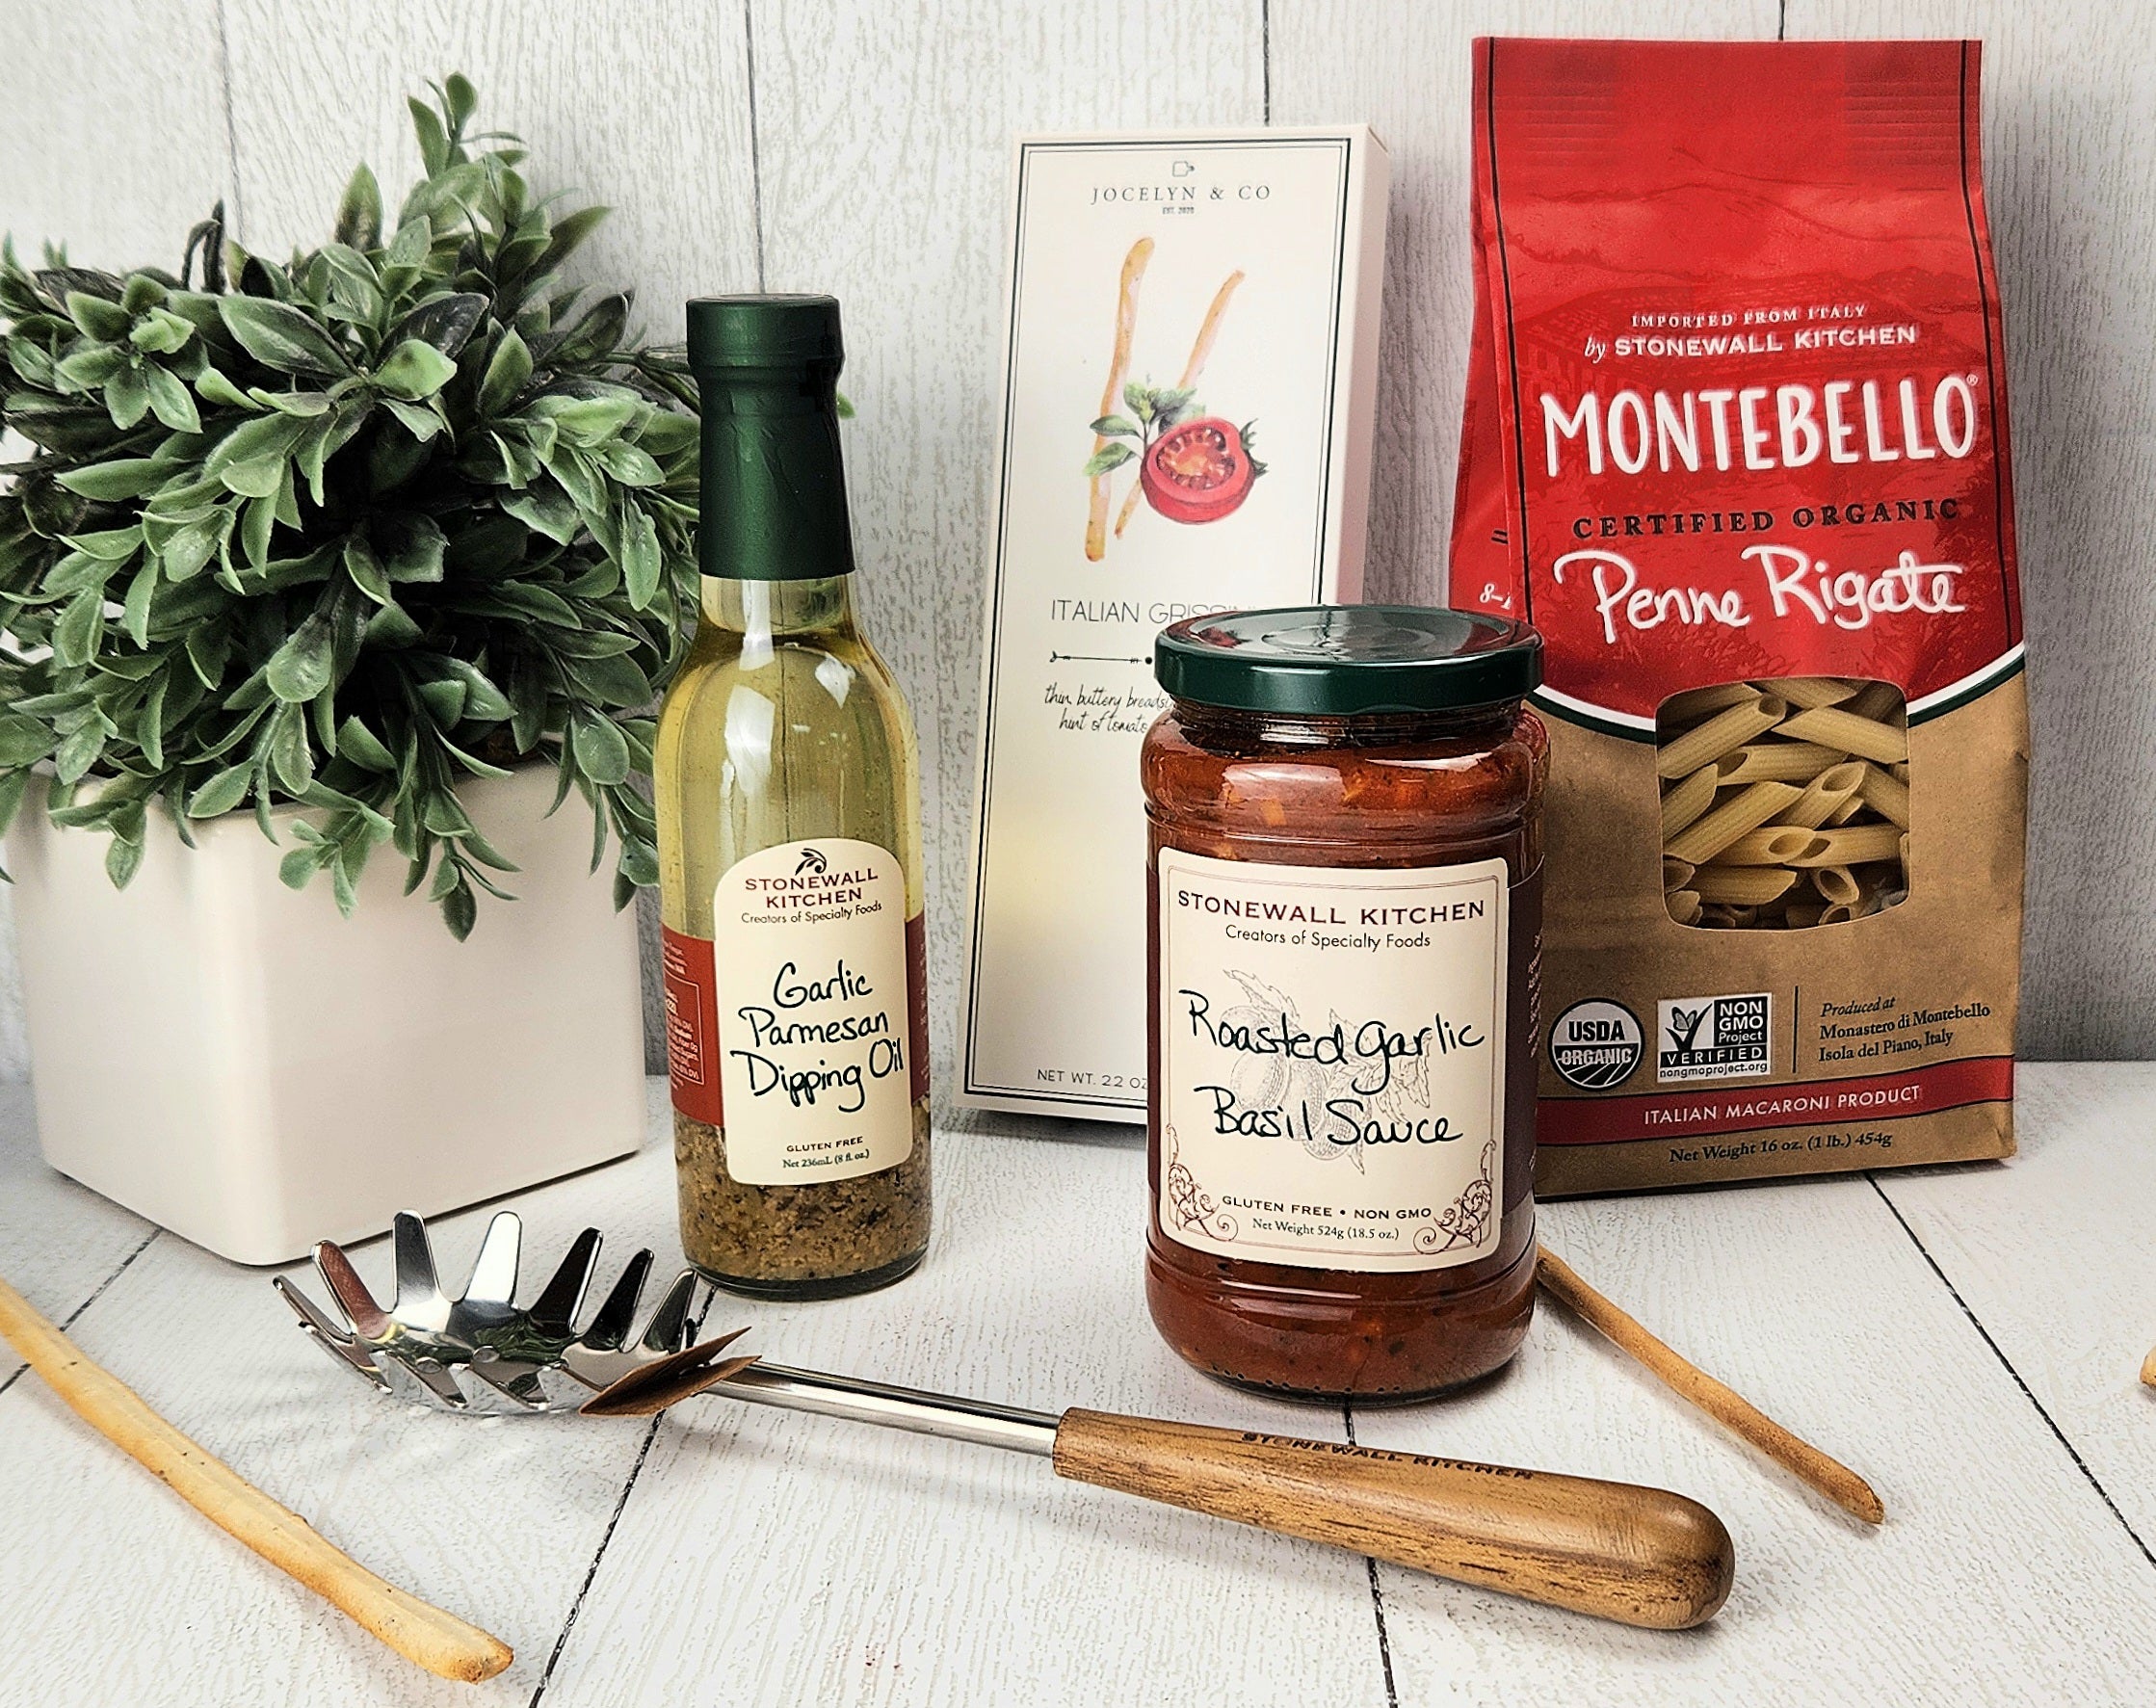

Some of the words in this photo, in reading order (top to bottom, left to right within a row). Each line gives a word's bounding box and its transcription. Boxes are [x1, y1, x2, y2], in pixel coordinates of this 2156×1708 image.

[1091, 186, 1196, 205] JOCELYN
[1210, 186, 1224, 200] &
[1238, 185, 1270, 200] CO
[1631, 313, 1734, 328] IMPORTED
[1743, 309, 1798, 326] FROM
[1807, 304, 1866, 320] ITALY
[1585, 337, 1607, 363] by
[1615, 333, 1783, 357] STONEWALL
[1794, 325, 1917, 350] KITCHEN
[1573, 511, 1775, 539] CERTIFIED
[1792, 497, 1959, 530] ORGANIC
[1553, 549, 1751, 645] Penne
[1741, 544, 1965, 630] Rigate
[1051, 599, 1140, 623] ITALIAN
[1044, 682, 1072, 705] thin
[1077, 684, 1122, 712] buttery
[1060, 708, 1089, 731] hint
[1091, 710, 1110, 732] of
[1108, 712, 1148, 734] tomato
[745, 868, 879, 891] STONEWALL
[766, 887, 862, 908] KITCHEN
[1177, 890, 1347, 925] STONEWALL
[1359, 900, 1485, 926] KITCHEN
[741, 912, 787, 924] Creators
[790, 911, 802, 923] of
[805, 907, 853, 924] Specialty
[855, 900, 882, 915] Foods
[1225, 924, 1285, 944] Creators
[1291, 929, 1307, 945] of
[1311, 931, 1380, 953] Specialty
[1385, 932, 1431, 949] Foods
[773, 959, 874, 1009] Garlic
[1719, 1000, 1763, 1016] NON
[1820, 996, 1881, 1018] Produced
[1882, 996, 1897, 1010] at
[737, 1006, 889, 1048] Parmesan
[1178, 989, 1349, 1065] Roasted
[1568, 1019, 1625, 1042] USDA
[1719, 1015, 1764, 1032] GMO
[1819, 1021, 1895, 1040] Monastero
[1897, 1013, 1910, 1031] di
[1912, 1003, 1991, 1027] Montebello
[1718, 1031, 1763, 1045] Project
[1818, 1045, 1854, 1062] Isola
[1857, 1041, 1880, 1058] del
[1882, 1038, 1923, 1055] Piano,
[1924, 1028, 1954, 1047] Italy
[1561, 1047, 1633, 1065] ORGANIC
[1667, 1047, 1763, 1065] VERIFIED
[729, 1050, 866, 1113] Dipping
[869, 1037, 905, 1079] Oil
[1038, 1069, 1065, 1082] NET
[1071, 1072, 1096, 1086] WT.
[1659, 1062, 1768, 1078] nongmoproject.org
[1193, 1085, 1313, 1142] Basil
[1326, 1098, 1464, 1145] Sauce
[1644, 1105, 1718, 1125] ITALIAN
[1725, 1096, 1830, 1118] MACARONI
[1837, 1085, 1920, 1108] PRODUCT
[786, 1142, 831, 1152] GLUTEN
[835, 1136, 863, 1147] FREE
[1669, 1148, 1698, 1163] Net
[1702, 1143, 1755, 1161] Weight
[1760, 1140, 1779, 1153] 16
[1781, 1140, 1803, 1151] oz.
[1806, 1136, 1822, 1151] (1
[1826, 1133, 1852, 1149] lb.)
[1854, 1132, 1893, 1147] 454g
[782, 1159, 799, 1169] Net
[802, 1156, 832, 1168] 236mL
[834, 1154, 844, 1165] (8
[1222, 1196, 1284, 1213] GLUTEN
[1291, 1204, 1333, 1217] FREE
[1354, 1209, 1389, 1220] NON
[1395, 1207, 1432, 1220] GMO
[1252, 1218, 1272, 1231] Net
[1275, 1221, 1314, 1237] Weight
[1317, 1225, 1345, 1240] 524g
[1347, 1226, 1375, 1240] (18.5
[1378, 1227, 1400, 1241] oz.)
[1242, 1432, 1404, 1461] STONEWALL
[1413, 1456, 1534, 1480] KITCHEN
